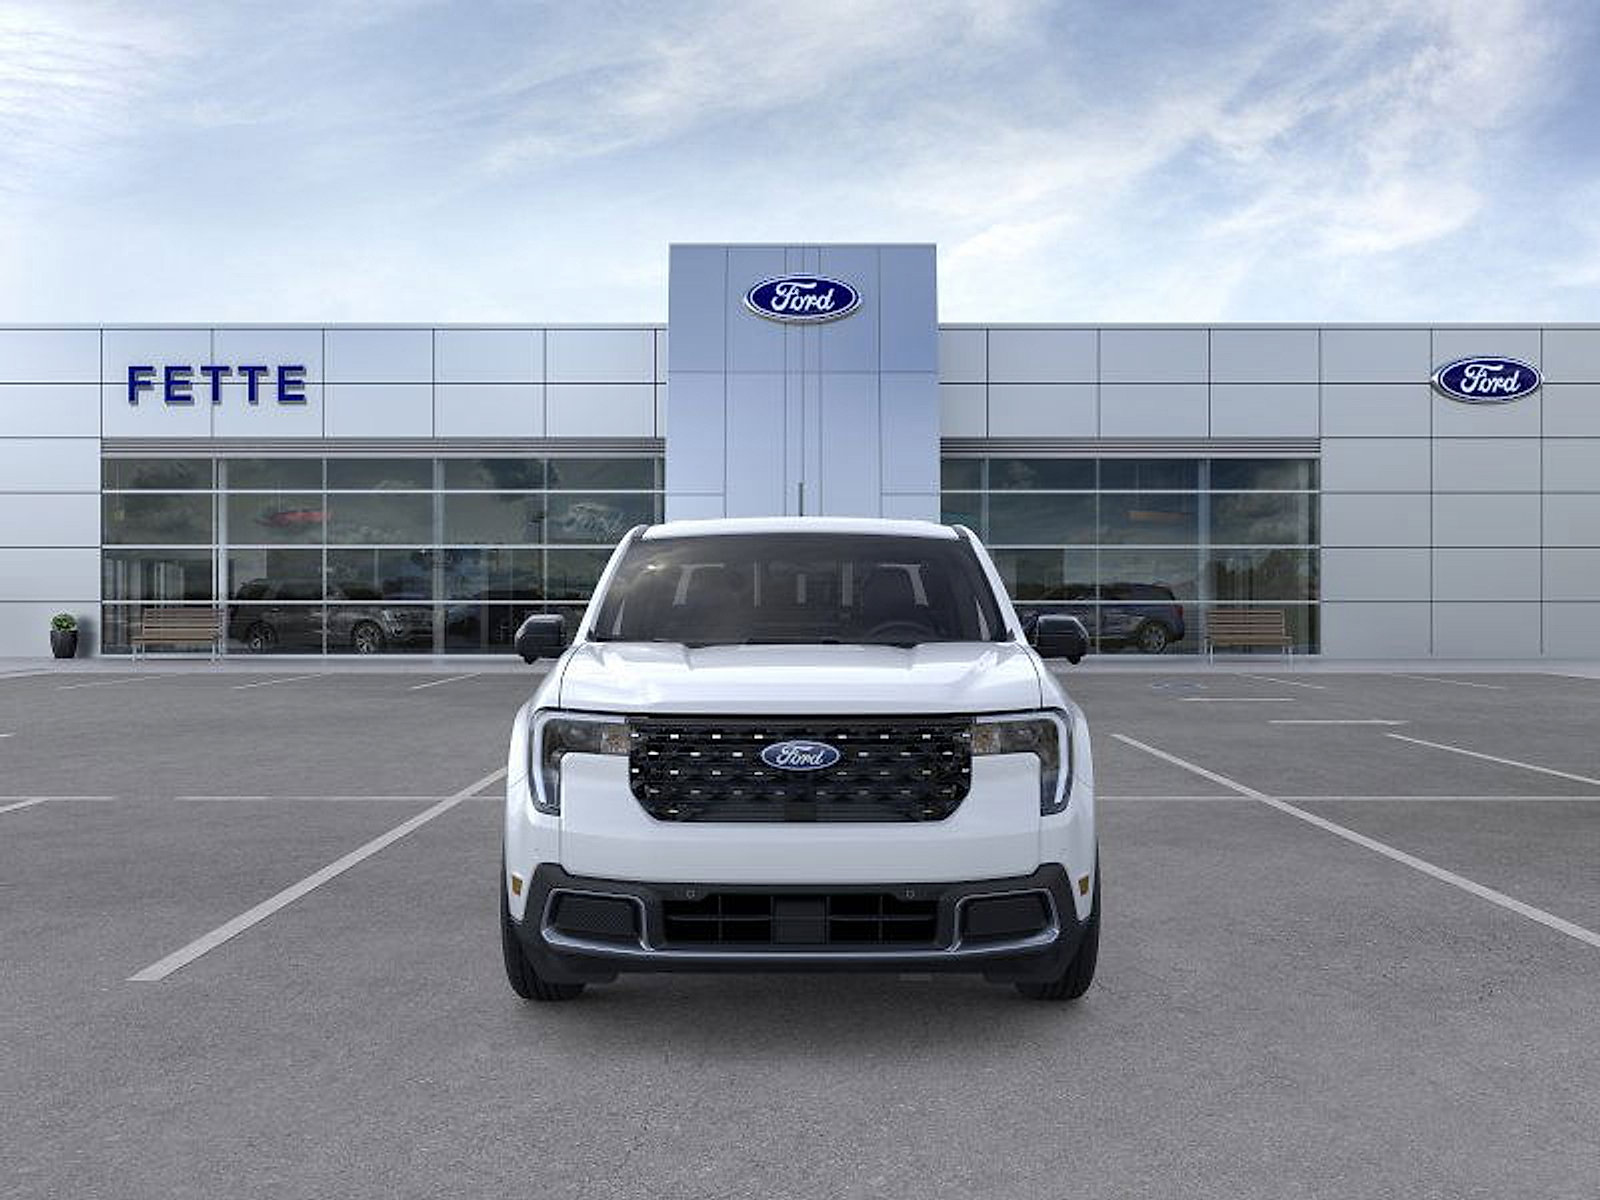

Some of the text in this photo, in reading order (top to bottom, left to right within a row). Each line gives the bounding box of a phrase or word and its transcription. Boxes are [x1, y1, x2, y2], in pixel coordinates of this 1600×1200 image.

[771, 282, 835, 311] Ford
[128, 365, 307, 404] FETTE
[1461, 364, 1520, 393] Ford
[776, 745, 825, 765] Ford
